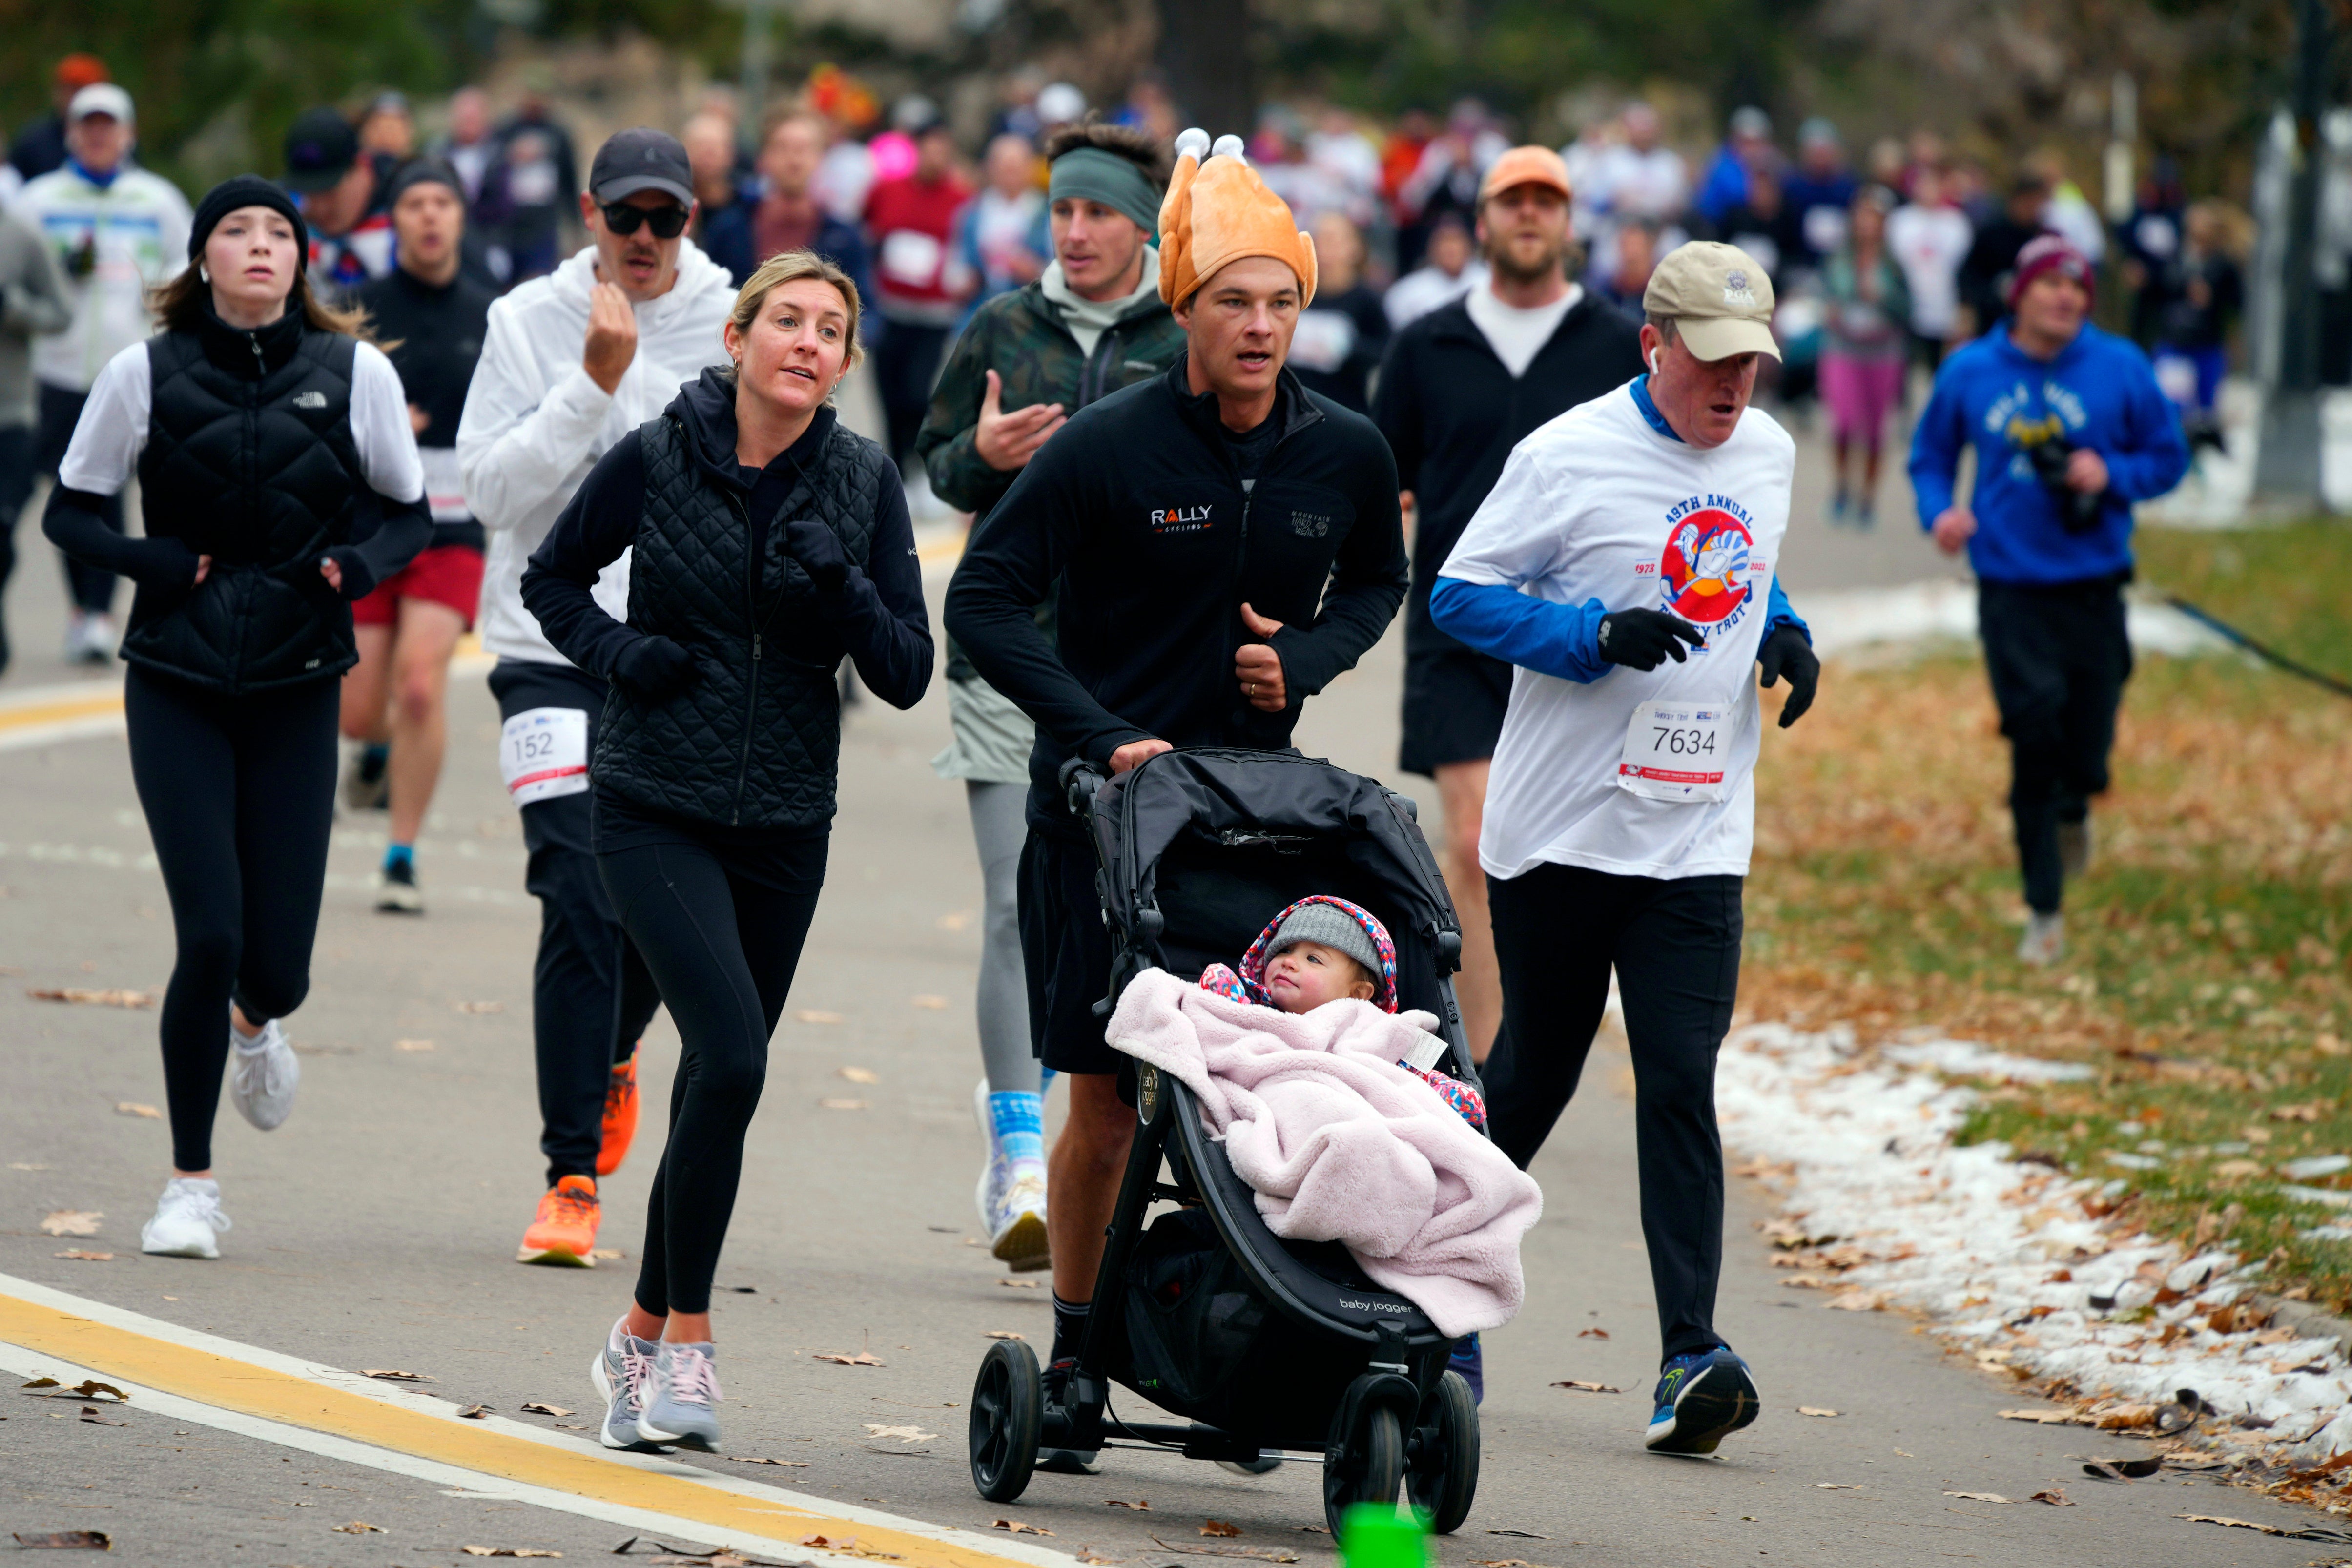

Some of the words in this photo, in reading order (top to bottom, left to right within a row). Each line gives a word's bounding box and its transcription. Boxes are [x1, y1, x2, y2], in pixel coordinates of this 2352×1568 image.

[1723, 288, 1755, 303] PGA
[1151, 504, 1212, 525] RALLY
[1291, 510, 1330, 522] MOUNTAIN
[1666, 496, 1701, 524] 49TH
[1707, 494, 1754, 529] ANNUAL
[1165, 523, 1201, 533] CYCLING
[1635, 563, 1655, 574] 1973
[1716, 604, 1746, 635] TROT
[515, 731, 553, 762] 152
[1653, 726, 1715, 755] 7634
[1143, 1072, 1154, 1090] baby
[1141, 1091, 1156, 1105] jogger
[1339, 1298, 1370, 1311] baby
[1373, 1301, 1413, 1313] jogger
